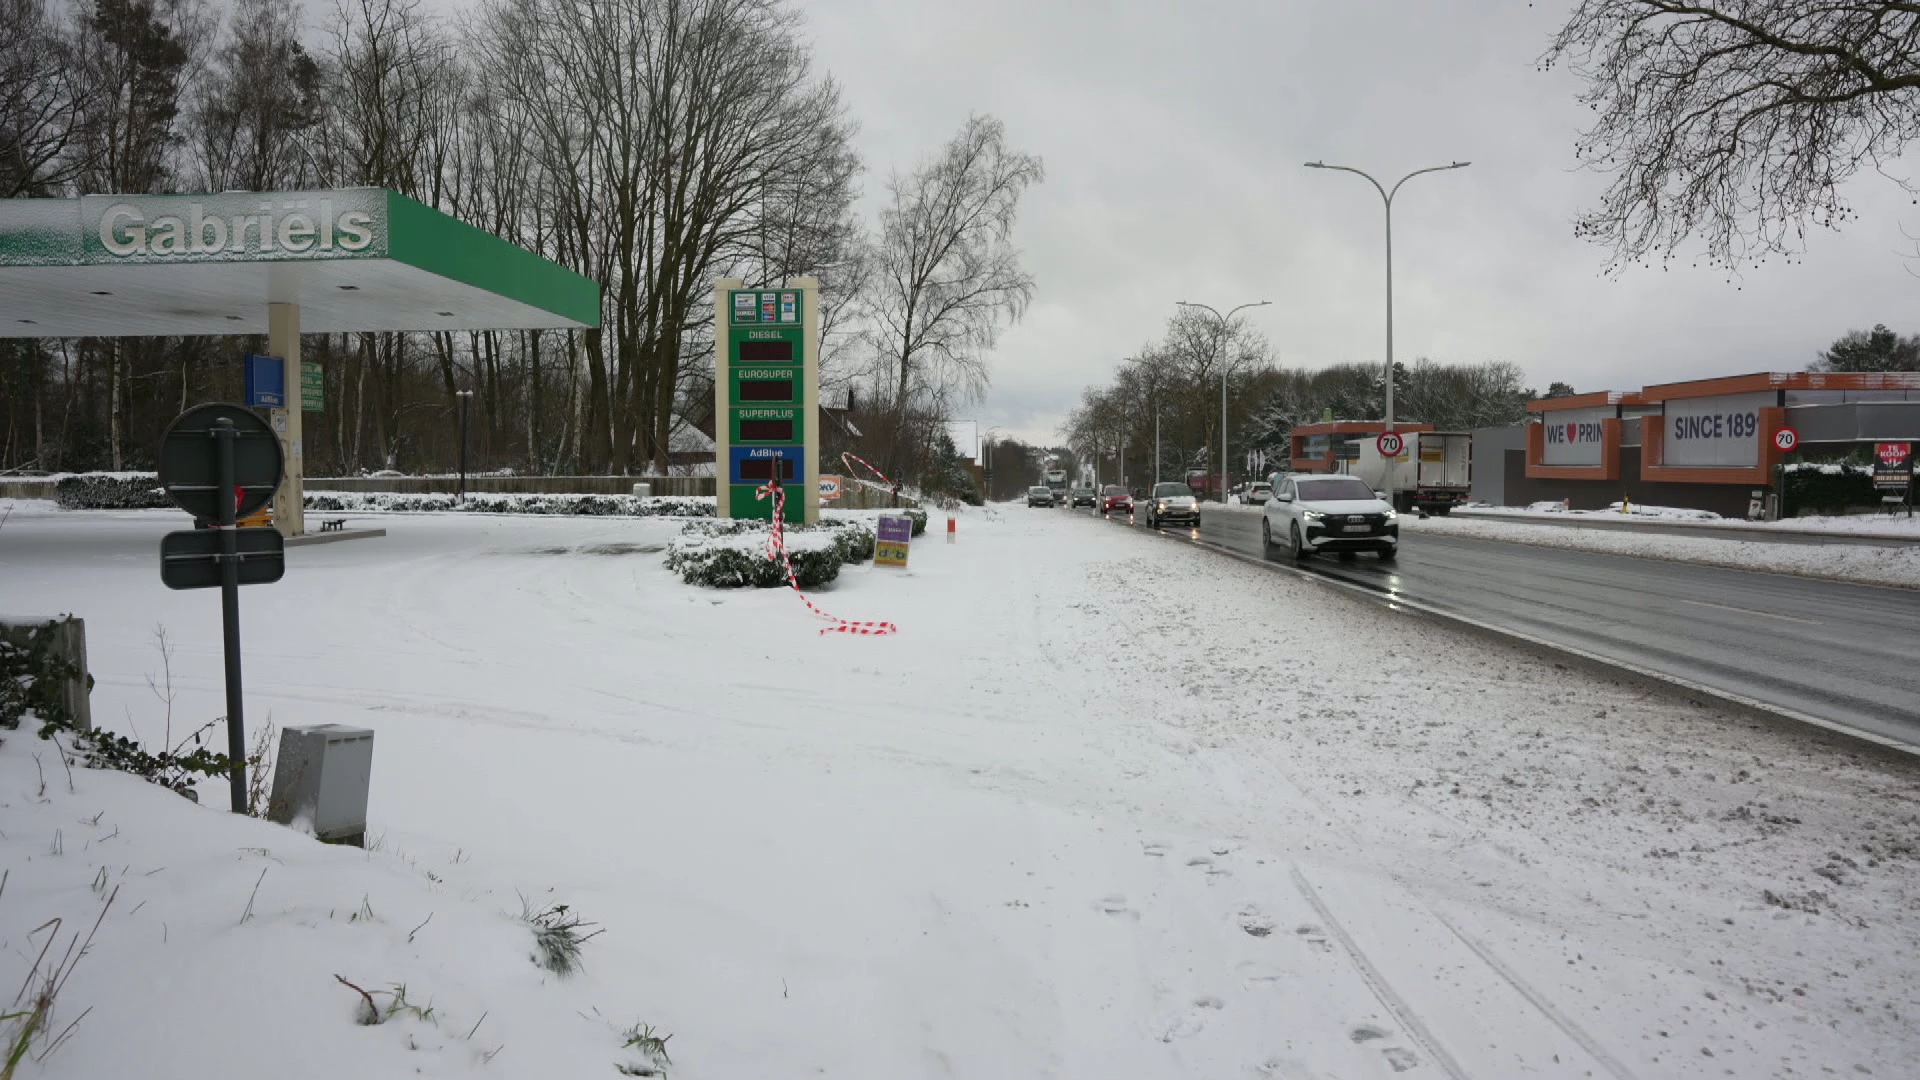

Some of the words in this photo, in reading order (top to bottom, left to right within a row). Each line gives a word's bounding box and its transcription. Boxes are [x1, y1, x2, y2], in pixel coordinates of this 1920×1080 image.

[99, 200, 373, 256] Gabriëls
[749, 330, 783, 339] DIESEL
[738, 370, 793, 379] EUROSUPER
[739, 409, 793, 419] SUPERPLUS
[1675, 415, 1723, 440] SINCE
[1726, 412, 1759, 438] 189
[1547, 424, 1565, 444] WE
[1778, 433, 1793, 445] 70
[1383, 438, 1398, 450] 70
[750, 448, 784, 457] AdBlue
